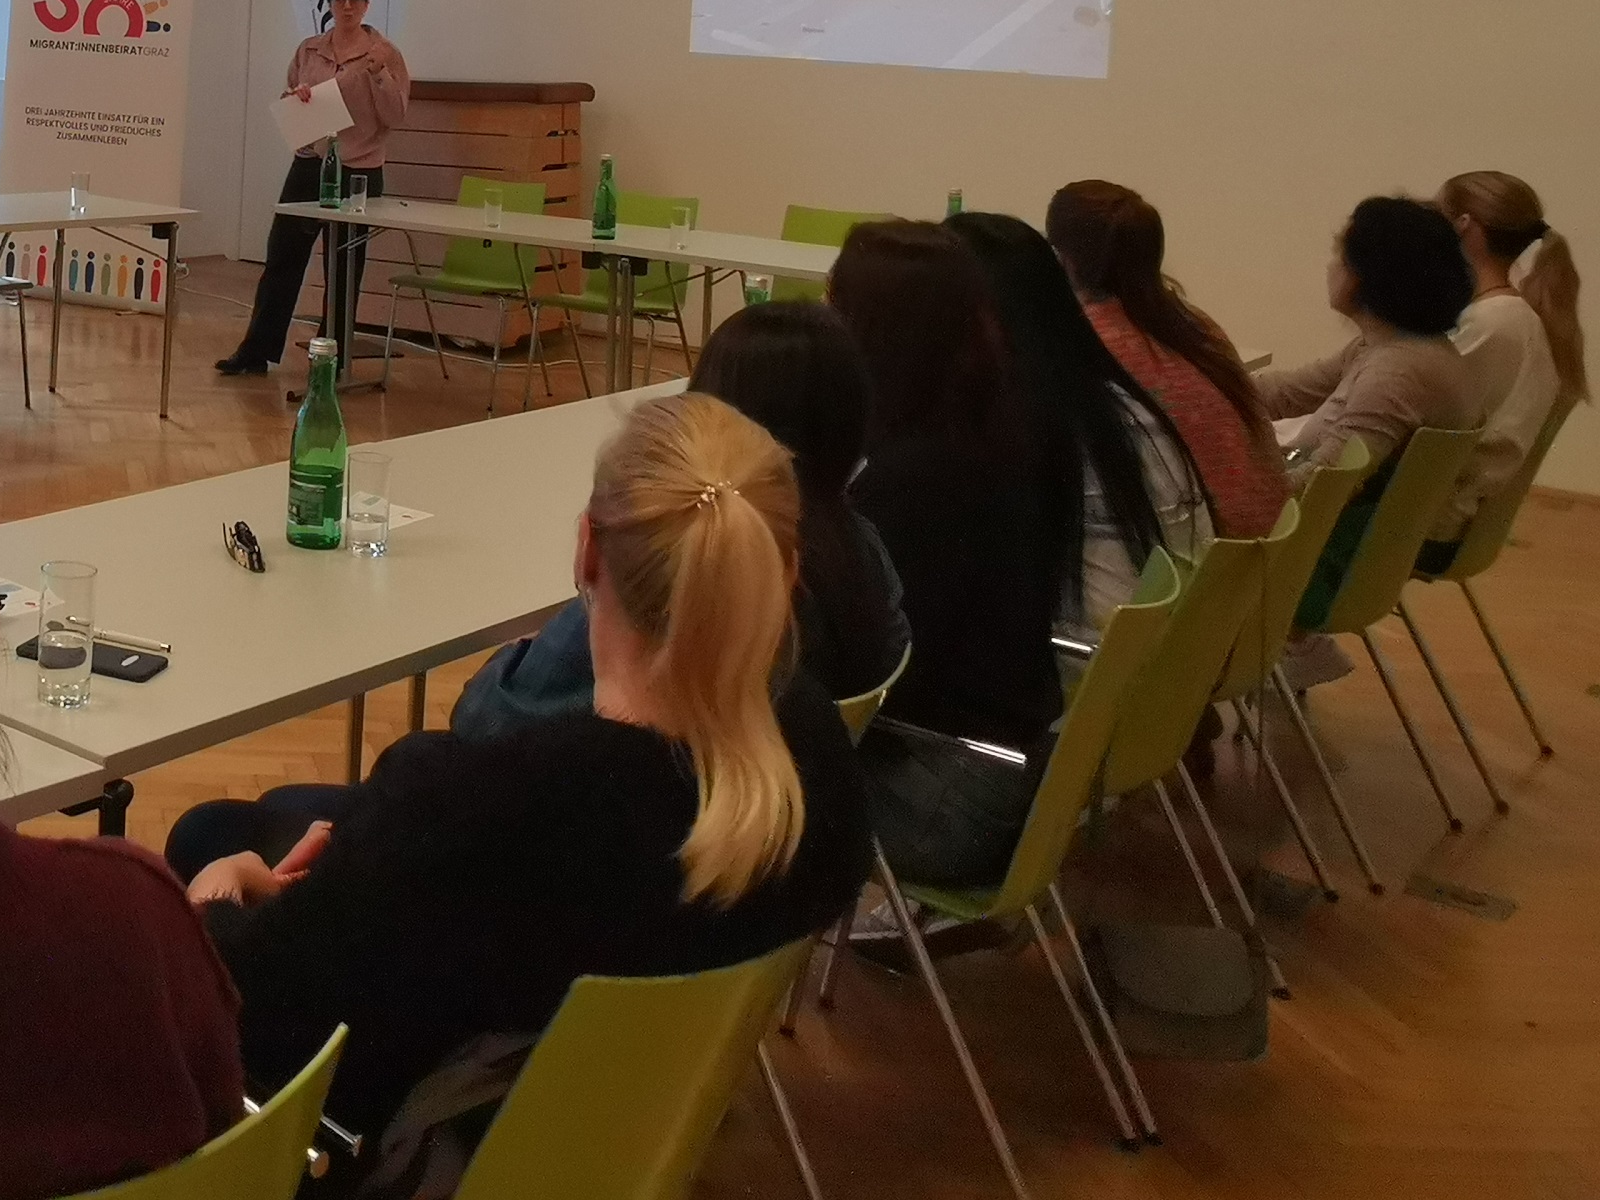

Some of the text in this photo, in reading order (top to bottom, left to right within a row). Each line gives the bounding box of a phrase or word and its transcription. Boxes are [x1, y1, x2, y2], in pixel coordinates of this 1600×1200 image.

[24, 106, 165, 126] DREI JAHRZEHNTE EINSATZ FÜR EIN
[25, 117, 89, 131] RESPEKTVOLLES
[90, 123, 109, 133] UND
[56, 131, 128, 146] ZUSAMMENLEBEN
